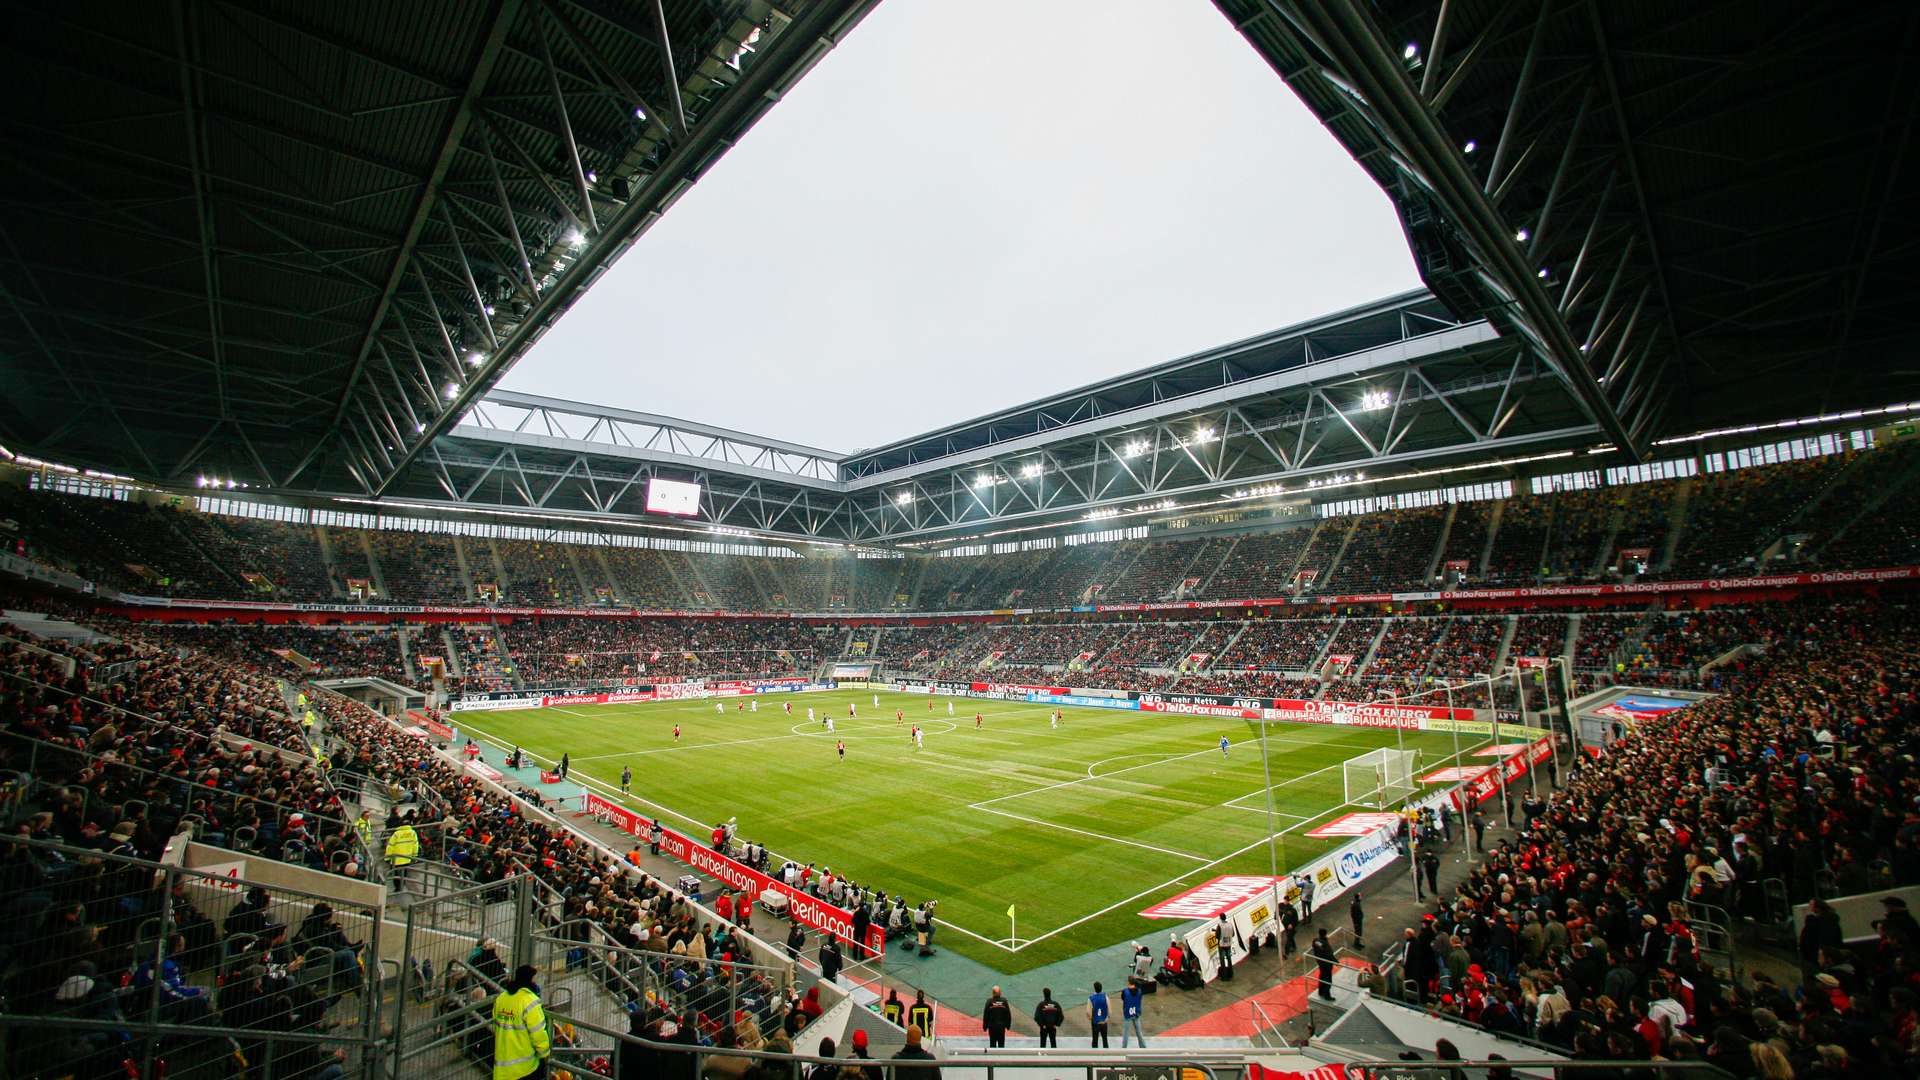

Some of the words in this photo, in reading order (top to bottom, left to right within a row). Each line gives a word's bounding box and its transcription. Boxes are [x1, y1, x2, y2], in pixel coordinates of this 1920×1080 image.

[1821, 571, 1873, 582] TelDaFax
[1875, 570, 1911, 579] ENERGY
[1624, 583, 1670, 592] TelDaFax
[1671, 582, 1703, 590] ENERGY
[1719, 578, 1766, 588] TelDaFax
[1766, 577, 1799, 586] ENERGY
[1452, 591, 1488, 600] TelDaFax
[1490, 590, 1517, 598] ENERGY
[1529, 587, 1570, 596] TelDaFax
[1572, 586, 1602, 595] ENERGY
[1028, 687, 1051, 696] ENRGY
[554, 695, 598, 705] airberlin.com
[1171, 696, 1191, 704] mehr
[1194, 696, 1218, 705] Netto
[1166, 703, 1210, 714] TelDaFax
[1211, 707, 1244, 717] ENERGY
[1317, 703, 1381, 716] TelDaFax
[1383, 708, 1432, 719] ENERGY
[1276, 710, 1333, 722] BAUHAUS
[1353, 715, 1418, 728] BAUHAUS
[640, 823, 685, 857] airbin.com
[698, 851, 757, 895] airberlin.com
[785, 890, 855, 940] berlin.com
